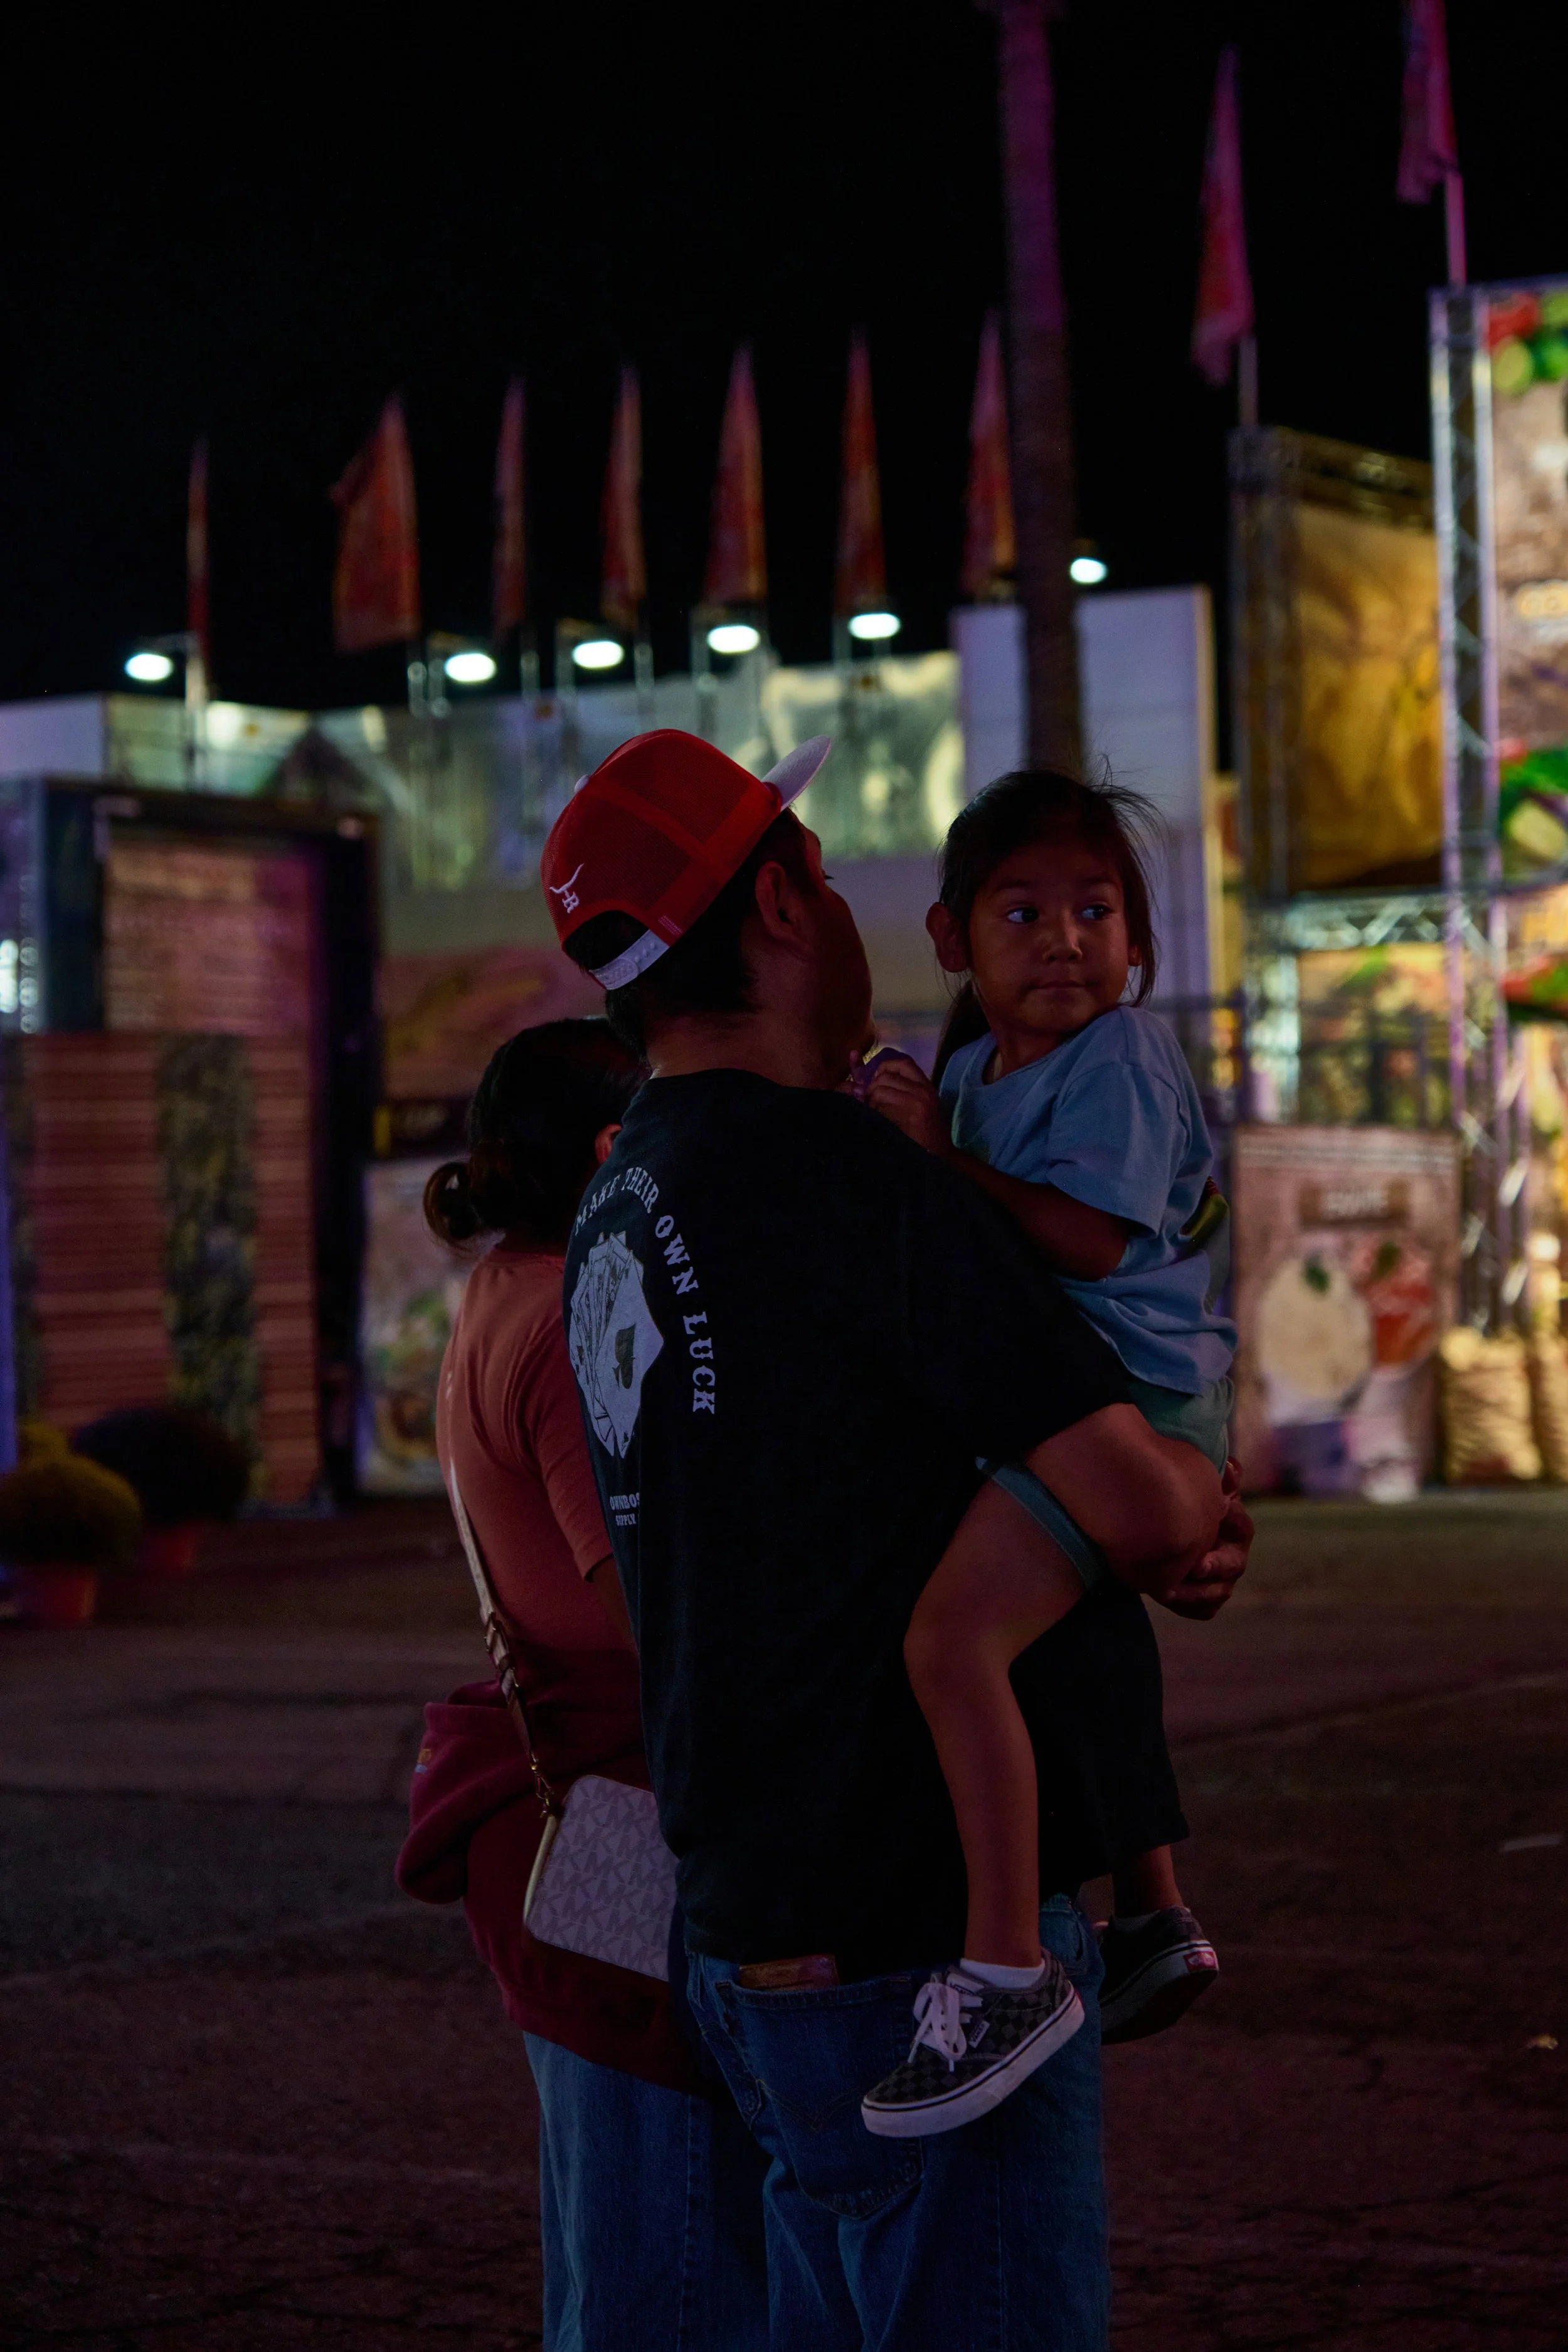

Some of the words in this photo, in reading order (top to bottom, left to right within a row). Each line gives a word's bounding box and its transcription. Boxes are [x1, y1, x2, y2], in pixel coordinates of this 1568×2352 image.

[575, 1173, 621, 1236] MAKE
[621, 1167, 659, 1214] THEIR
[655, 1215, 700, 1295] OWN
[682, 1311, 716, 1414] LUCK
